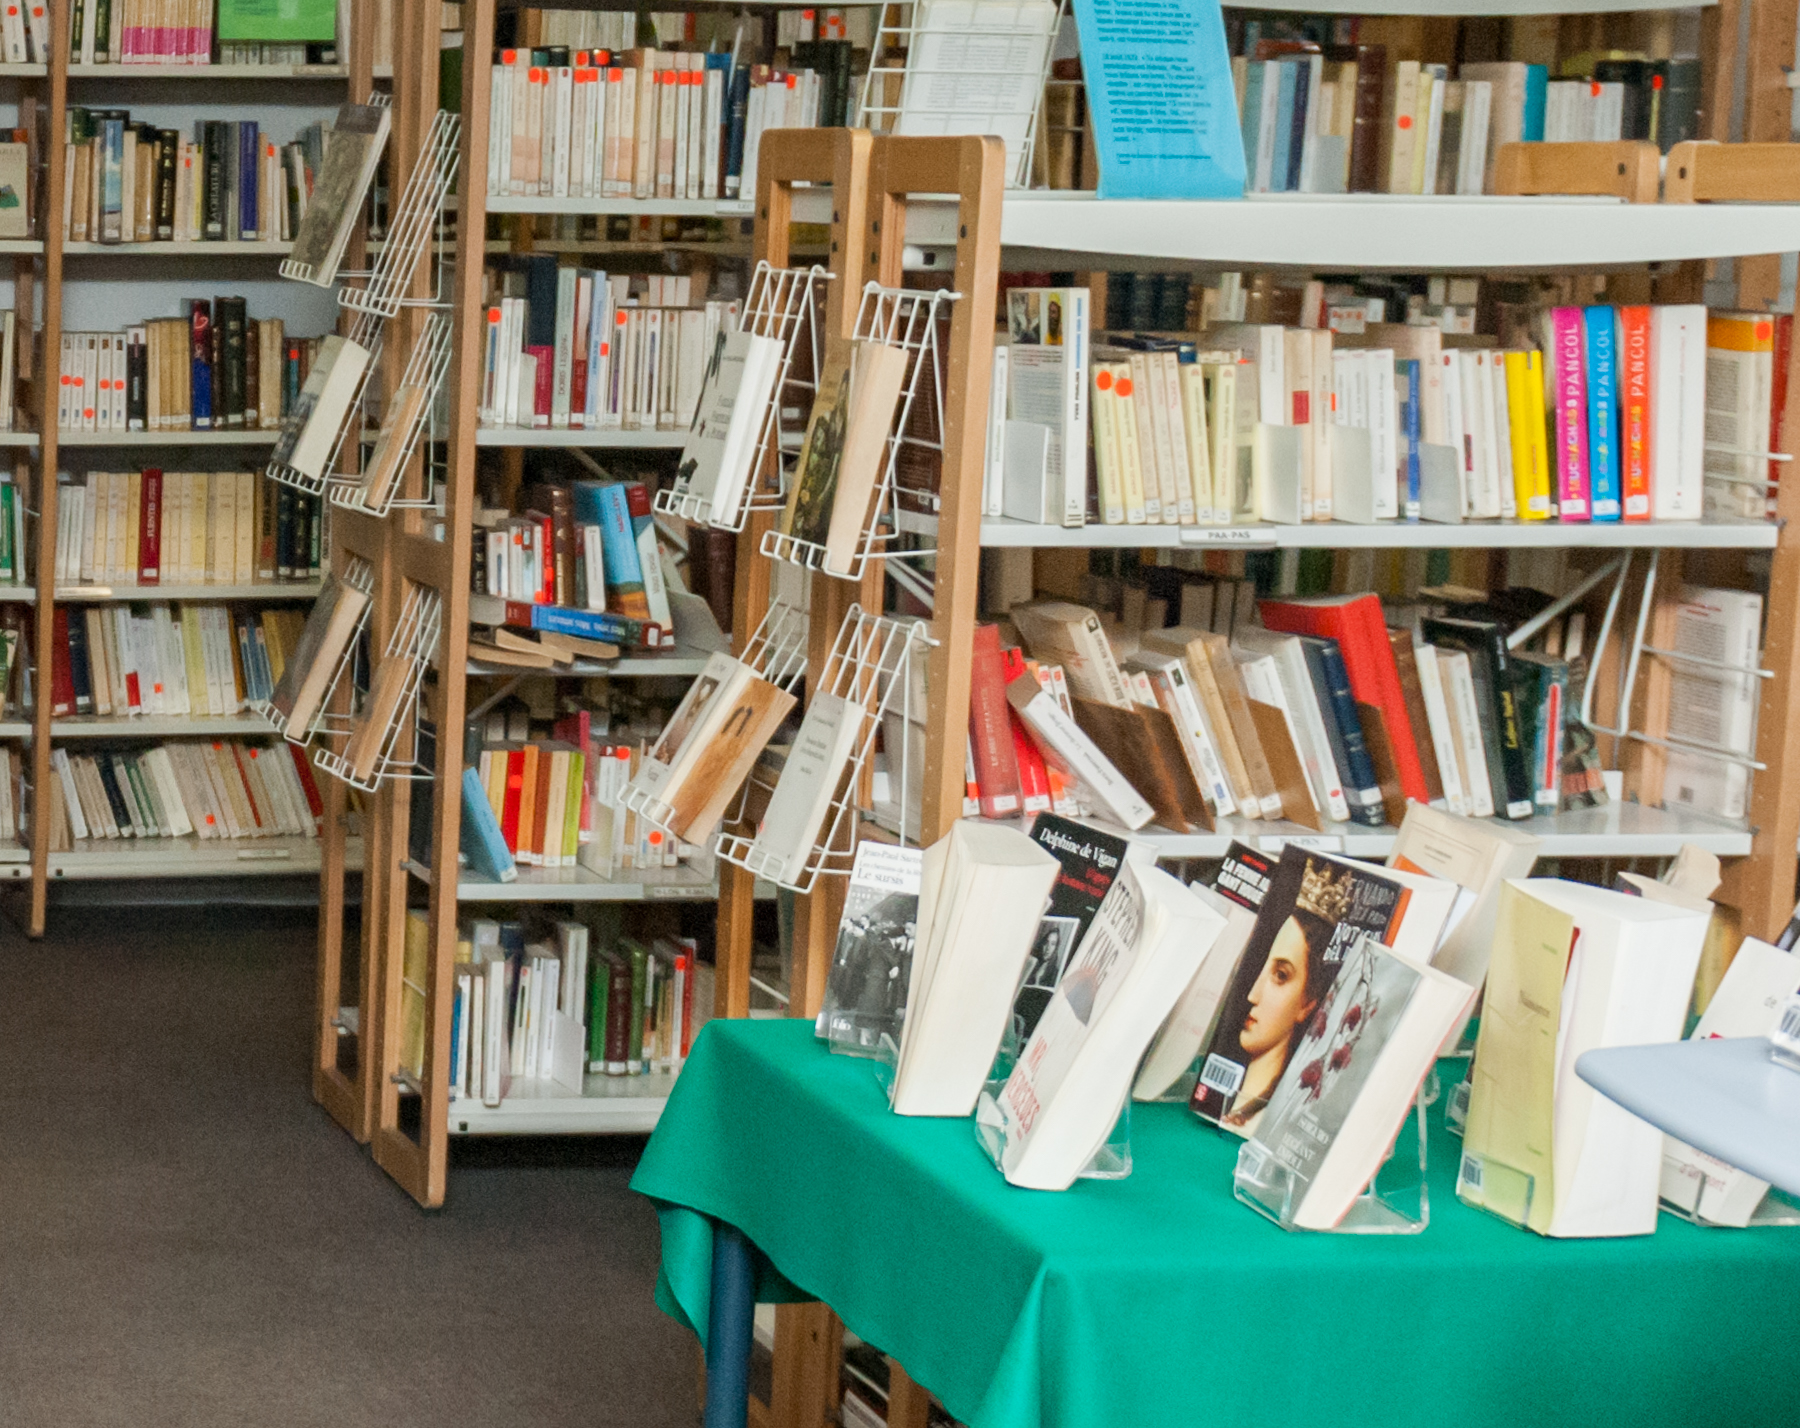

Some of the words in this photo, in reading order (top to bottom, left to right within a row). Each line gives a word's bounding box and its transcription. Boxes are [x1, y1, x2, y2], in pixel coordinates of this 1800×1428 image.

[1563, 323, 1581, 396] PANCOL
[1596, 329, 1611, 396] PANCOL
[1629, 324, 1645, 396] PANCOL
[1566, 409, 1582, 491] MUCHACHAS
[1629, 406, 1644, 489] MUCHACHAS
[857, 868, 872, 879] Le
[874, 873, 904, 885] sursis
[862, 847, 899, 861] Jean-Paul
[1039, 827, 1081, 856] Delphine
[1079, 843, 1093, 861] de
[1093, 846, 1118, 869] Vigan
[1217, 869, 1239, 892] GANT
[1221, 857, 1235, 872] LA
[1234, 862, 1260, 886] FEMME
[1102, 886, 1140, 952] STEPHEN
[1080, 926, 1119, 990] KING
[1005, 1061, 1041, 1135] MERCEDES
